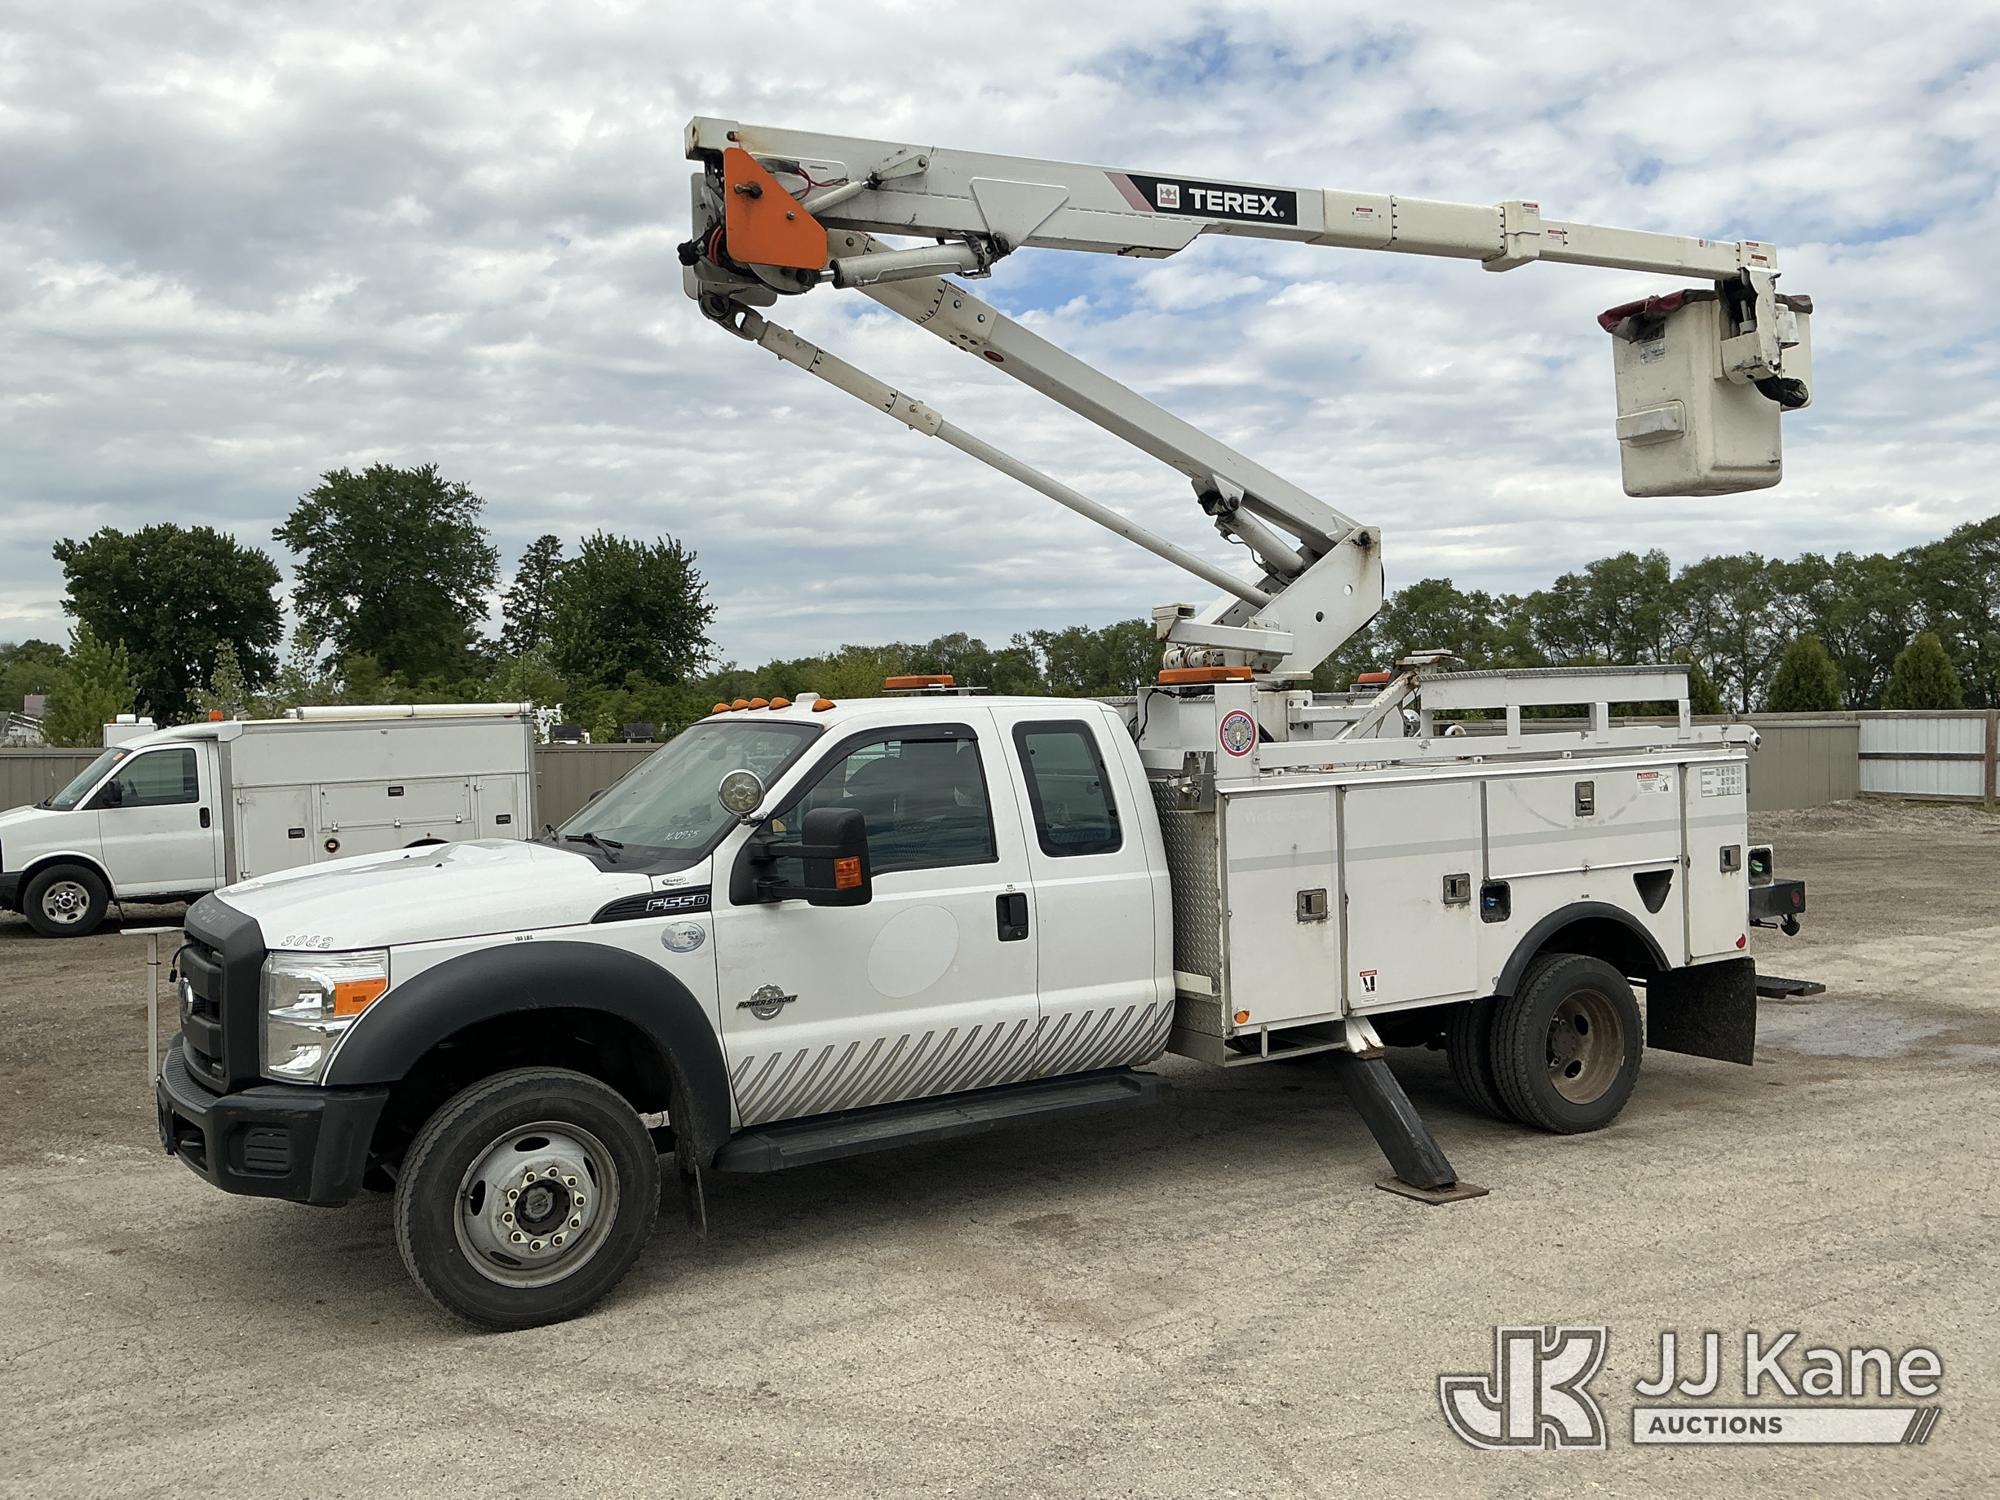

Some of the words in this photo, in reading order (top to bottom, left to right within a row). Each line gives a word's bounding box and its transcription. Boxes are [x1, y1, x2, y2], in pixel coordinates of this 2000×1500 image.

[1188, 188, 1279, 217] TEREX
[736, 1000, 766, 1010] POWER
[766, 994, 798, 1005] STROKE
